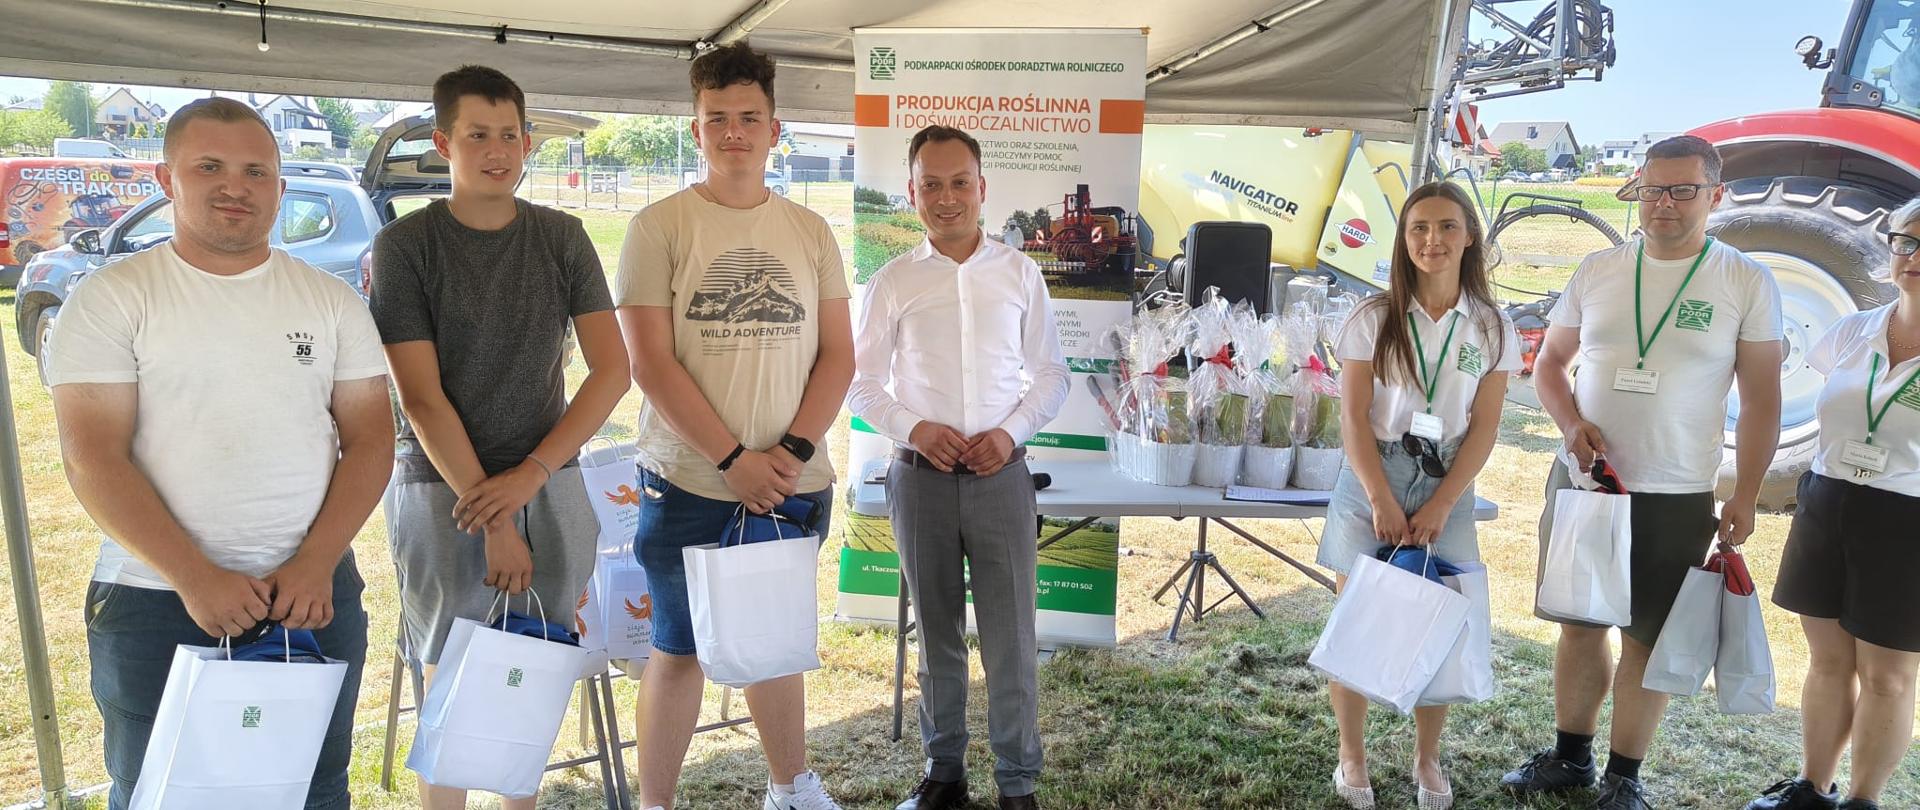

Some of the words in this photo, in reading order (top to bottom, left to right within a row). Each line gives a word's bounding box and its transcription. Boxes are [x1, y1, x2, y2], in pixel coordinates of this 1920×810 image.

[904, 60, 963, 70] PODKARPACKI
[965, 59, 1006, 71] OŚRODEK
[1008, 61, 1065, 72] DORADZTWA
[1067, 62, 1124, 73] ROLNICZEGO
[896, 95, 994, 114] PRODUKCJA
[999, 93, 1091, 113] ROŚLINNA
[904, 111, 1091, 133] DOŚWIADCZALNICTWO
[1010, 141, 1032, 149] ORAZ
[1033, 142, 1079, 152] SZKOLENIA,
[982, 151, 1032, 160] WIADCZYMY
[1033, 152, 1063, 161] POMOC
[994, 161, 1038, 171] PRODUKCJI
[1039, 162, 1081, 173] ROŚLINNEJ
[89, 170, 111, 182] do
[1210, 170, 1299, 215] NAVIGATOR
[1342, 225, 1369, 242] HARDI
[1681, 310, 1709, 319] PODR
[700, 328, 731, 338] WILD
[733, 326, 801, 338] ADVENTURE
[296, 345, 312, 355] 55
[872, 565, 899, 573] Tkaczow
